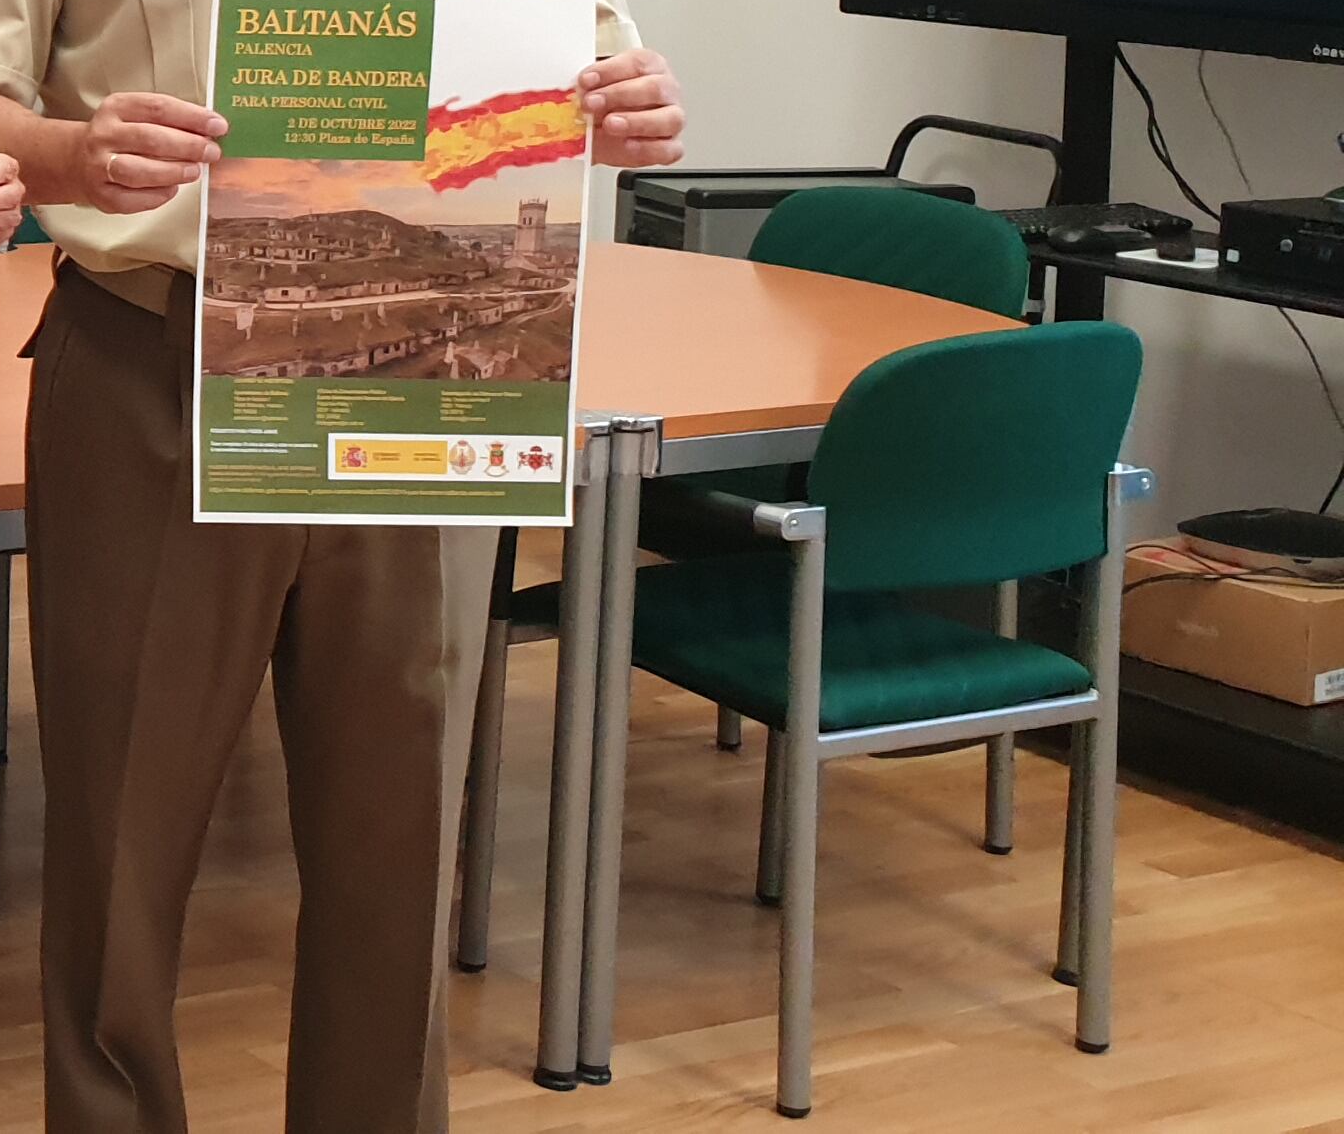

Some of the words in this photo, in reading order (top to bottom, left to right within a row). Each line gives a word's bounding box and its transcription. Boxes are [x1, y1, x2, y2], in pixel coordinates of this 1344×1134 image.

[236, 2, 417, 37] BALTANÁS
[234, 42, 313, 56] PALENCIA
[232, 68, 288, 86] JURA
[292, 69, 322, 86] DE
[327, 70, 427, 88] BANDERA
[231, 95, 268, 108] PARA
[271, 96, 346, 109] PERSONAL
[348, 97, 387, 109] CIVIL
[287, 118, 295, 129] 2
[298, 118, 317, 129] DE
[320, 118, 385, 130] OCTUBRE
[388, 119, 417, 130] 2022
[319, 133, 351, 144] Plaza
[354, 133, 368, 144] de
[371, 133, 415, 146] España
